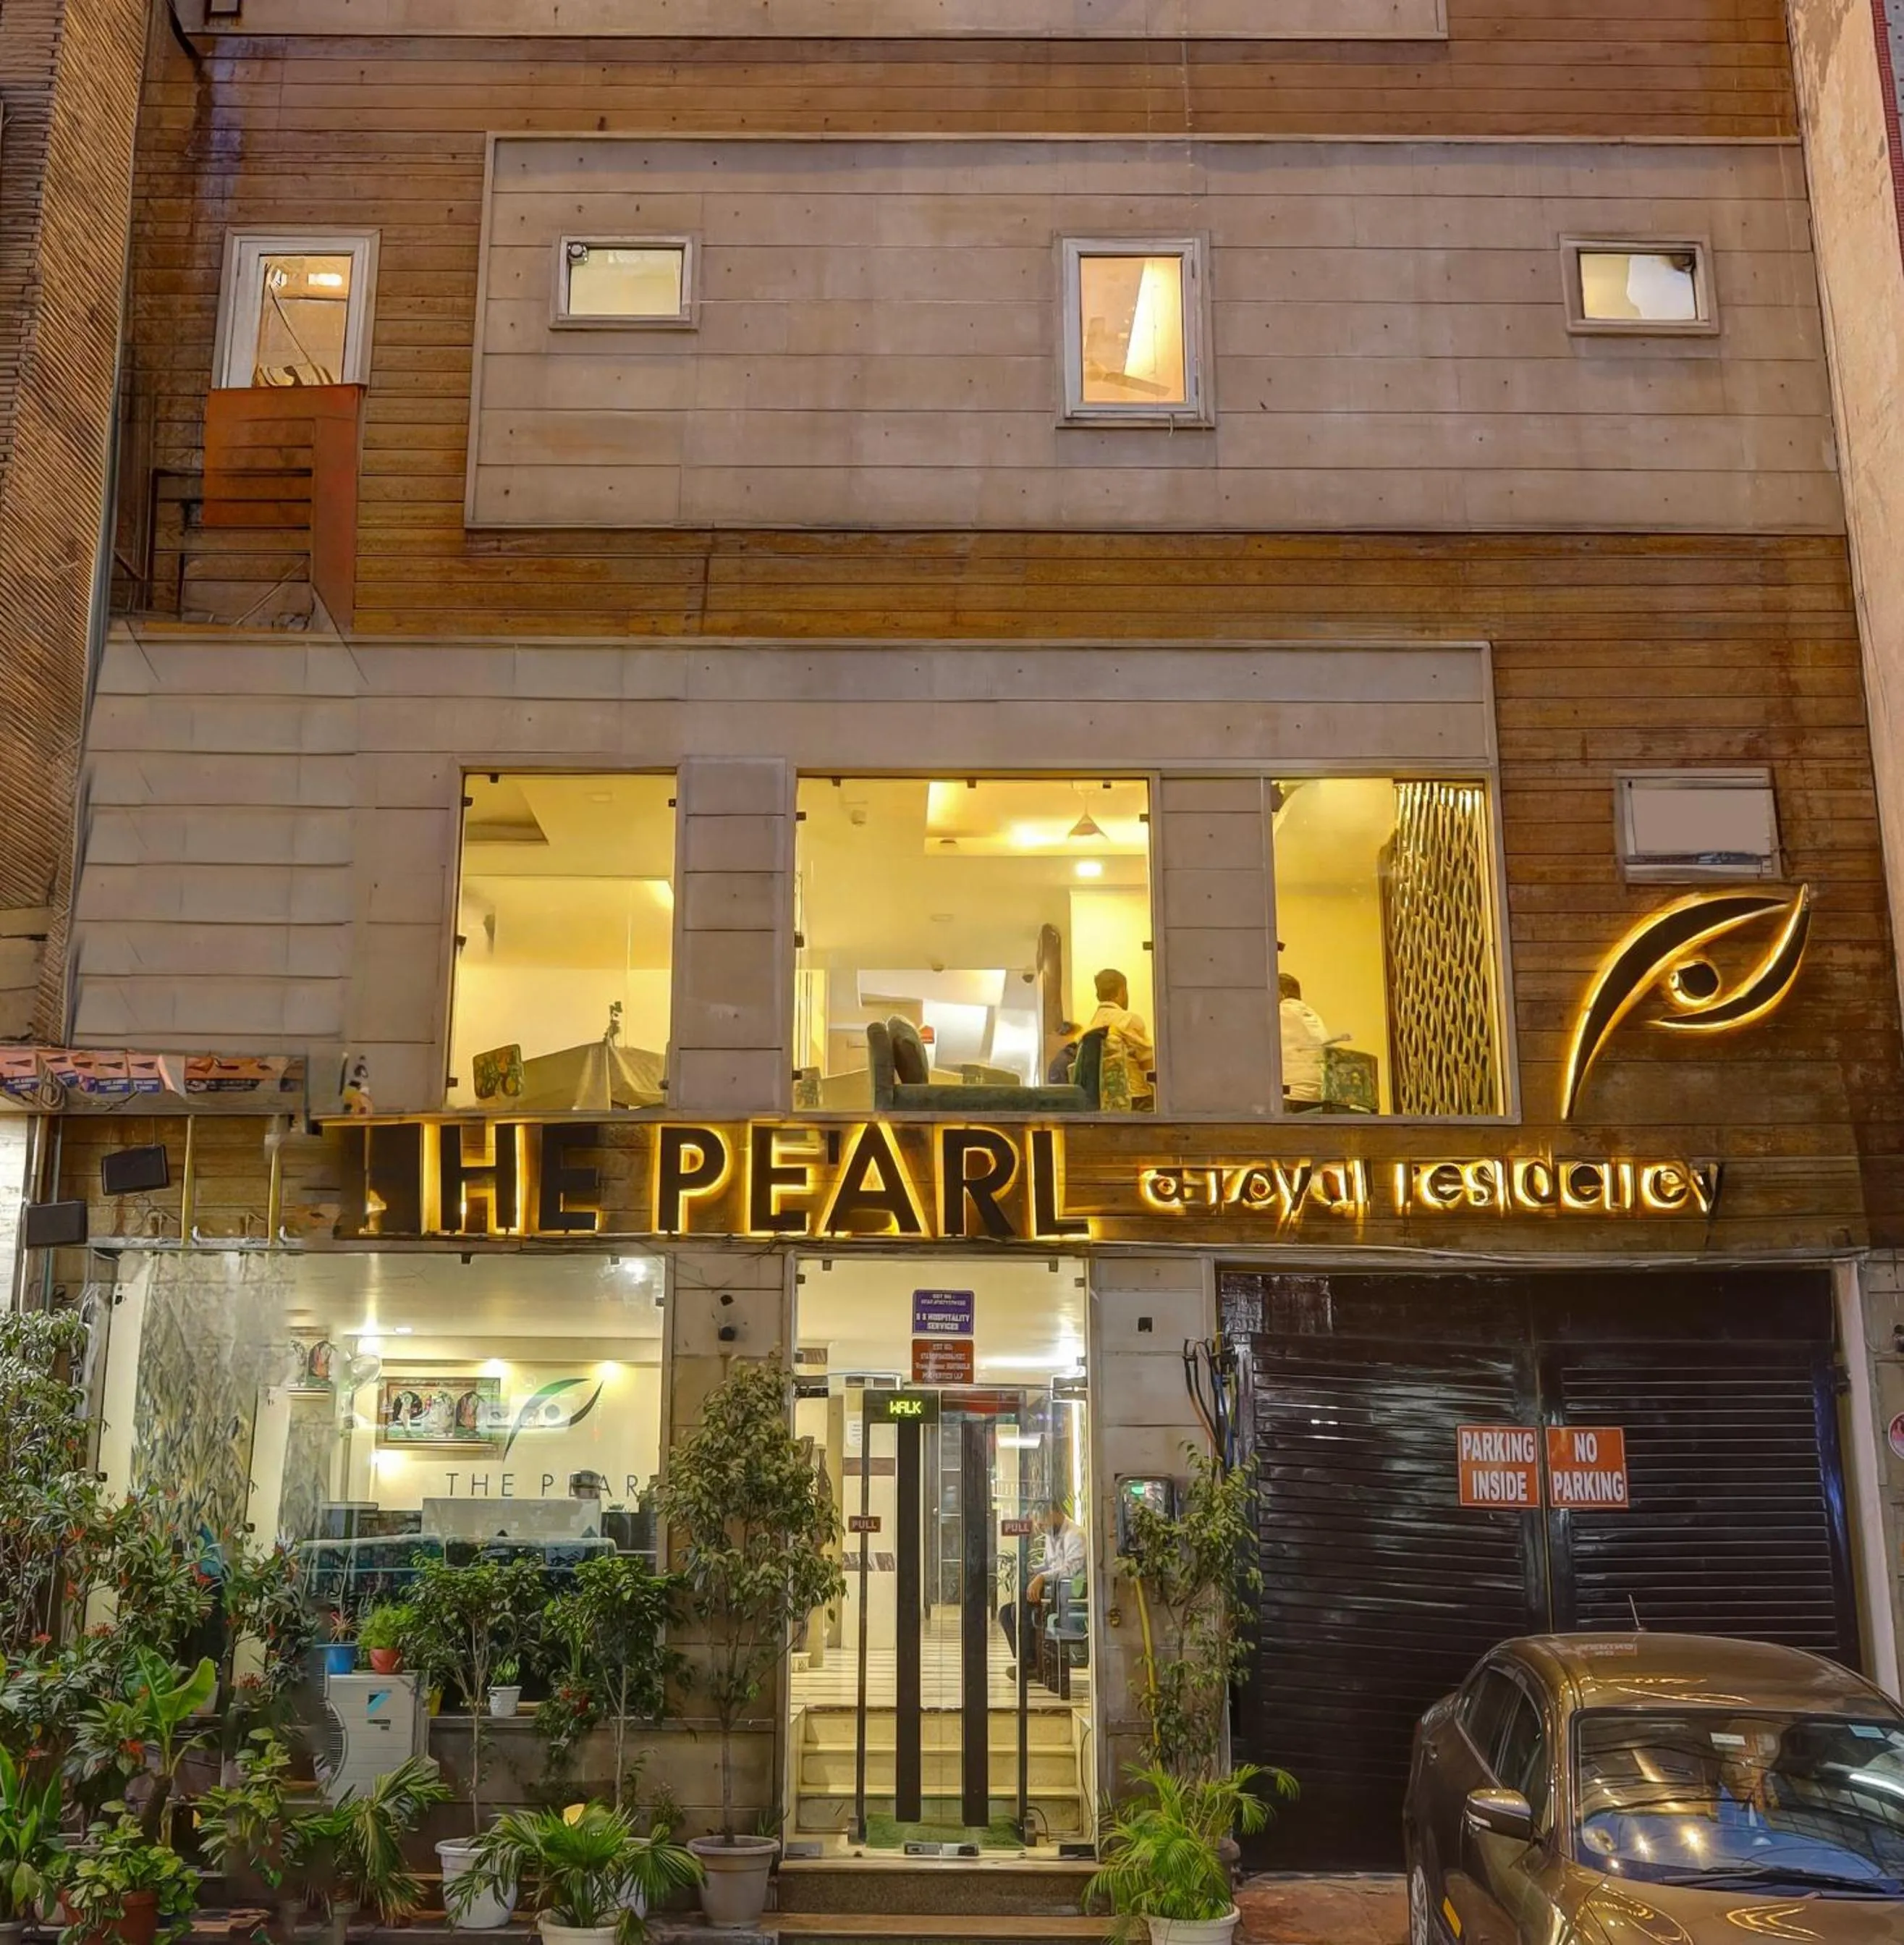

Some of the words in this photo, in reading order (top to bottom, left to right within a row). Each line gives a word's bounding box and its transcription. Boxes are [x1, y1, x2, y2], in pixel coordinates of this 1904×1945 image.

[654, 1121, 1093, 1238] PEARL
[1207, 1157, 1373, 1233] royal
[928, 1313, 970, 1323] HOSPITALITY
[889, 1401, 923, 1415] WALK
[1461, 1432, 1535, 1464] PARKING
[1573, 1433, 1598, 1463] NO
[445, 1473, 516, 1496] THE
[1472, 1470, 1528, 1501] INSIDE
[1553, 1471, 1624, 1502] PARKING
[851, 1520, 877, 1530] PULL
[1004, 1524, 1030, 1532] PULL
